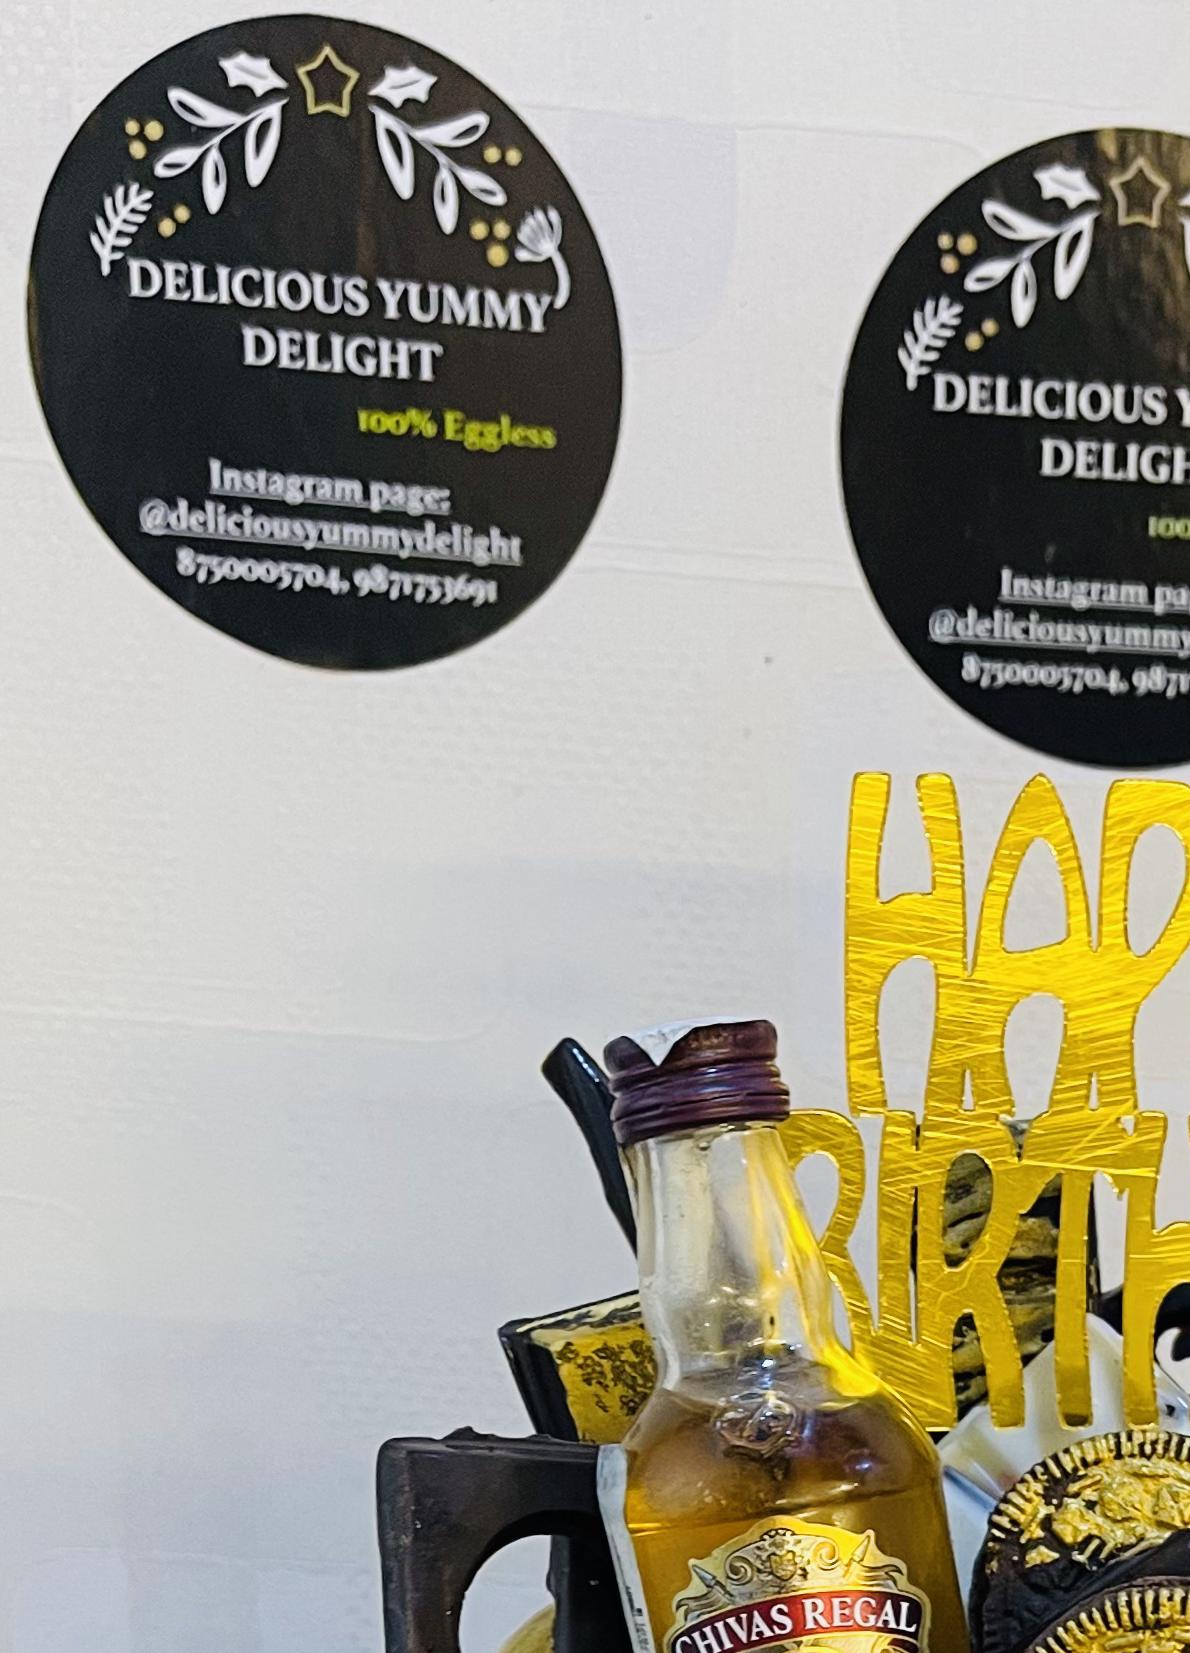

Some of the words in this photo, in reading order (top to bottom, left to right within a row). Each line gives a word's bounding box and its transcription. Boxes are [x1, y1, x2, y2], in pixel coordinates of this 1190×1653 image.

[128, 257, 369, 318] DELICIOUS
[377, 276, 553, 332] YUMMY
[242, 324, 443, 383] DELIGHT
[933, 372, 1167, 425] DELICIOUS
[357, 407, 437, 439] 100%
[444, 410, 557, 452] Eggless
[208, 456, 364, 506] Instagram
[370, 478, 451, 516] page:
[139, 496, 523, 566] @deliciousyummydelight
[999, 564, 1149, 611] Instagram
[800, 1596, 918, 1634] REGAL
